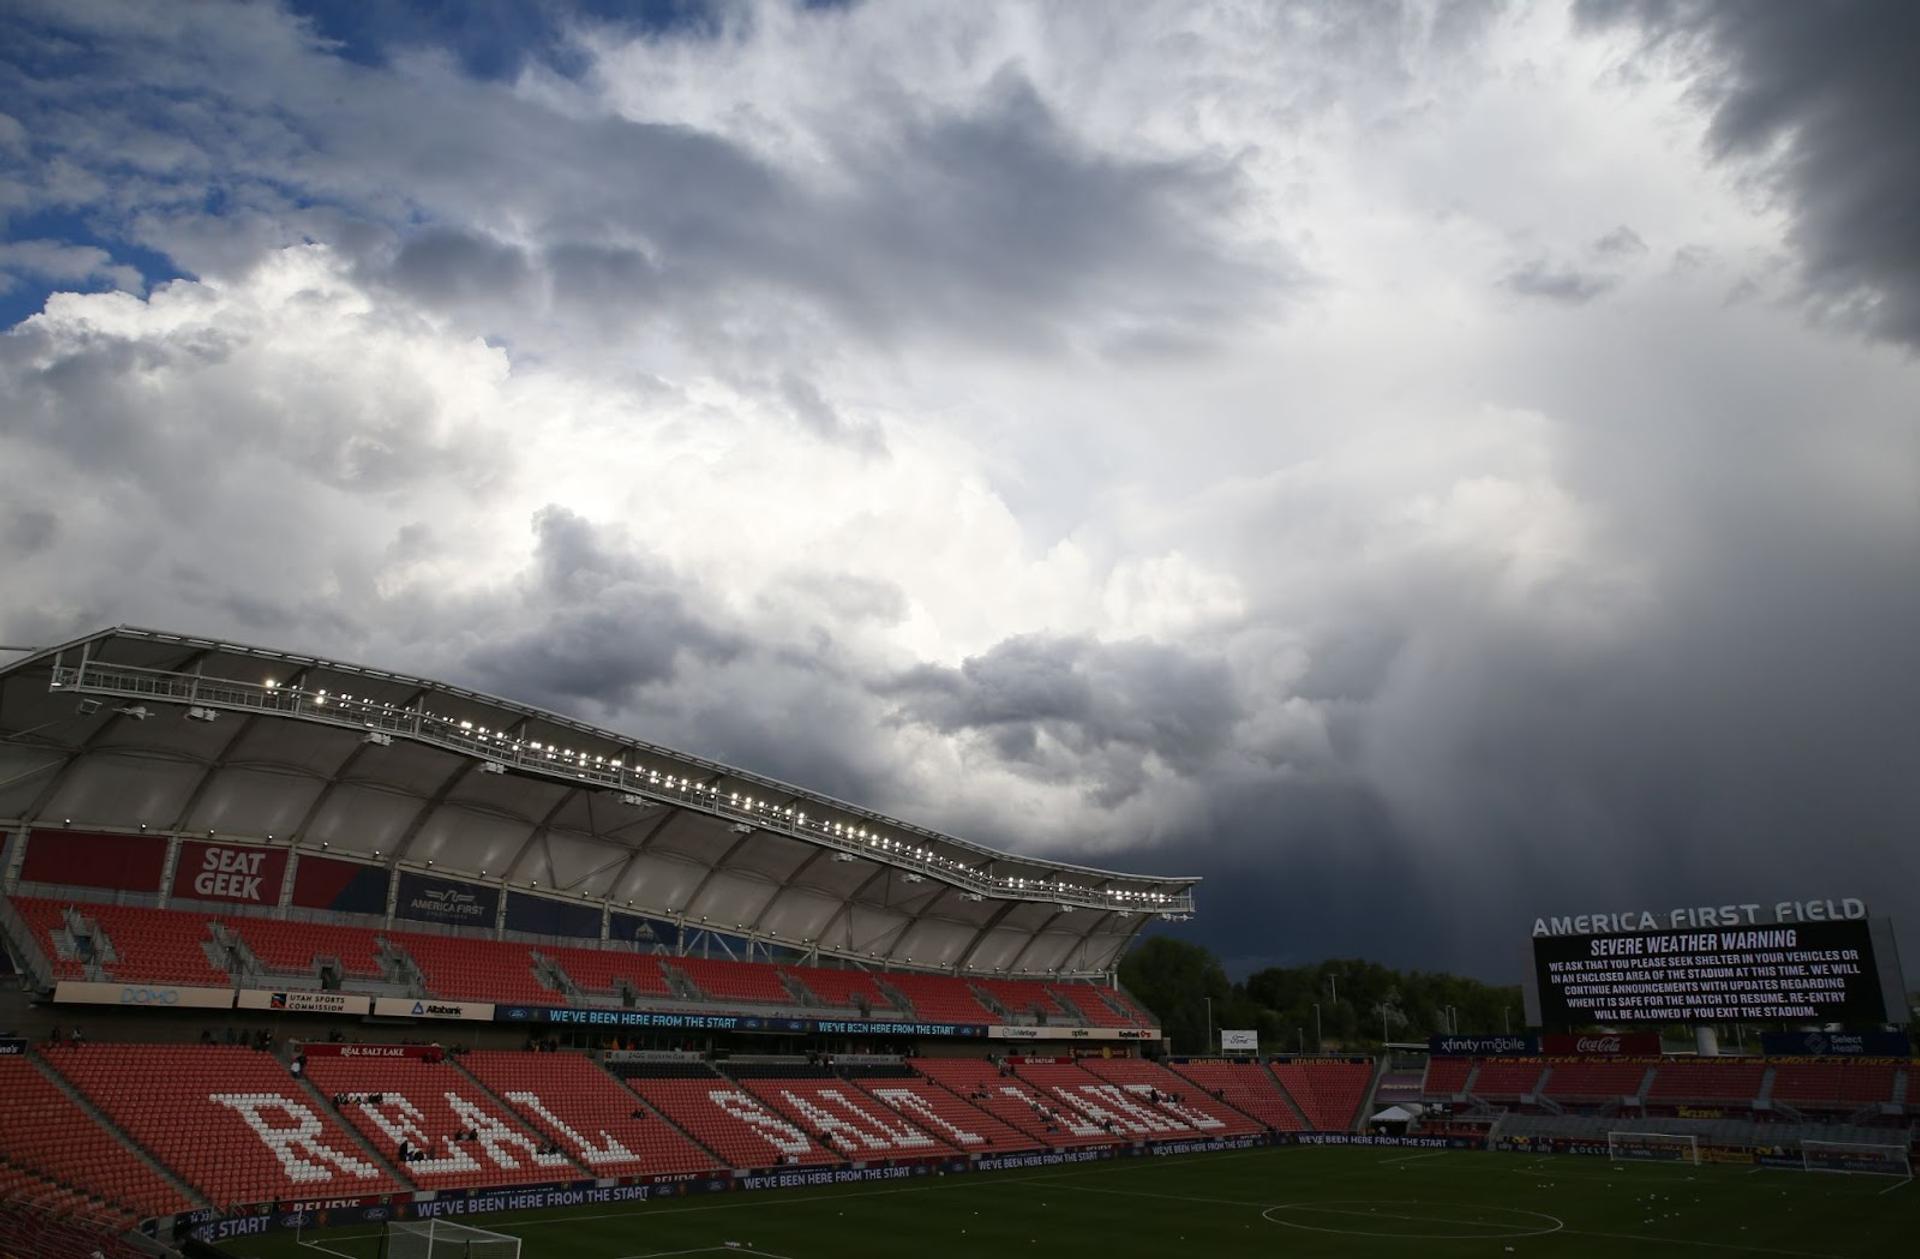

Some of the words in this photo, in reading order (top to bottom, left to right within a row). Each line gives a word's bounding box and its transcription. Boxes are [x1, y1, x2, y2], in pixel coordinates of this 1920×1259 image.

[202, 847, 265, 874] SEAT
[194, 871, 264, 900] GEEK
[410, 898, 456, 913] AMERICA
[457, 903, 485, 916] FIRST
[1532, 911, 1659, 937] AMERICA
[1670, 904, 1760, 928] FIRST
[1775, 898, 1865, 923] FIELD
[1590, 937, 1643, 957] SEVERE
[1646, 933, 1718, 955] WEATHER
[1721, 929, 1797, 951] WARNING
[1549, 962, 1564, 971] WE
[1565, 961, 1583, 971] ASK
[1585, 959, 1609, 970] THAT
[1610, 958, 1629, 969] YOU
[1630, 957, 1666, 969] PLEASE
[1667, 956, 1693, 967] SEEK
[1694, 954, 1742, 966] SHELTER
[1742, 953, 1754, 964] IN
[1755, 952, 1785, 963] YOUR
[1786, 950, 1840, 962] VEHICLES
[1841, 949, 1859, 961] OR
[1551, 974, 1561, 984] IN
[1562, 973, 1575, 983] AN
[1576, 971, 1625, 983] ENCLOSED
[1625, 970, 1651, 981] AREA
[1652, 969, 1665, 980] OF
[1667, 969, 1686, 980] THE
[1687, 967, 1734, 979] STADIUM
[1735, 967, 1751, 977] AT
[1752, 966, 1776, 977] THIS
[1777, 965, 1809, 976] TIME.
[1810, 964, 1830, 975] WE
[1831, 963, 1861, 974] WILL
[1564, 984, 1611, 996] CONTINUE
[1612, 981, 1699, 995] ANNOUNCEMENTS
[1700, 980, 1728, 992] WITH
[1729, 979, 1778, 991] UPDATES
[1780, 977, 1845, 990] REGARDING
[289, 1003, 344, 1011] COMMISSION
[316, 996, 345, 1004] SPORTS
[1566, 998, 1596, 1008] WHEN
[1596, 998, 1606, 1007] IT
[1607, 997, 1617, 1007] IS
[1618, 996, 1643, 1007] SAFE
[1644, 995, 1663, 1006] FOR
[1664, 995, 1685, 1005] THE
[1686, 993, 1722, 1005] MATCH
[1724, 993, 1739, 1004] TO
[1740, 992, 1788, 1004] RESUME.
[1789, 991, 1846, 1003] RE-ENTRY
[426, 1005, 462, 1016] Altabank
[550, 1010, 587, 1024] WE'VE
[589, 1011, 619, 1024] BEEN
[621, 1012, 649, 1026] HERE
[651, 1013, 683, 1027] FROM
[685, 1014, 705, 1028] THE
[706, 1016, 738, 1029] START
[1594, 1010, 1618, 1020] WILL
[1620, 1009, 1633, 1019] BE
[1634, 1008, 1681, 1019] ALLOWED
[1682, 1008, 1692, 1018] IF
[1694, 1007, 1715, 1018] YOU
[1716, 1006, 1742, 1017] EXIT
[1742, 1006, 1762, 1017] THE
[1763, 1005, 1819, 1017] STADIUM.
[818, 1021, 846, 1032] WE'VE
[847, 1023, 868, 1033] BEEN
[869, 1023, 891, 1034] HERE
[892, 1024, 915, 1035] FROM
[916, 1025, 931, 1035] THE
[931, 1025, 955, 1036] START
[1441, 1038, 1480, 1053] xfinity
[1481, 1038, 1525, 1052] mobile
[1830, 1035, 1863, 1044] Select
[340, 1046, 360, 1057] REAL
[361, 1047, 382, 1056] SALT
[383, 1048, 405, 1056] LAKE
[209, 1091, 640, 1183] REAL
[709, 1089, 985, 1155] SALT
[1208, 1141, 1224, 1150] FROM
[1299, 1135, 1324, 1145] WE'VE
[1325, 1136, 1349, 1145] BEEN
[1350, 1136, 1373, 1145] HERE
[1374, 1136, 1400, 1146] FROM
[1402, 1138, 1420, 1147] THE
[1421, 1138, 1448, 1148] START
[978, 1159, 1000, 1171] WE'VE
[1001, 1158, 1023, 1170] BEEN
[1024, 1156, 1042, 1168] HERE
[1043, 1155, 1063, 1166] FROM
[1063, 1154, 1076, 1164] THE
[1076, 1152, 1098, 1162] START
[743, 1176, 777, 1190] WE'VE
[779, 1174, 806, 1187] BEEN
[807, 1172, 833, 1185] HERE
[834, 1170, 863, 1182] FROM
[863, 1169, 882, 1180] THE
[883, 1166, 911, 1179] START
[417, 1200, 465, 1218] WE'VE
[468, 1198, 506, 1214] BEEN
[508, 1194, 545, 1210] HERE
[547, 1191, 584, 1207] FROM
[586, 1188, 611, 1203] THE
[613, 1186, 649, 1200] START
[218, 1216, 271, 1238] START
